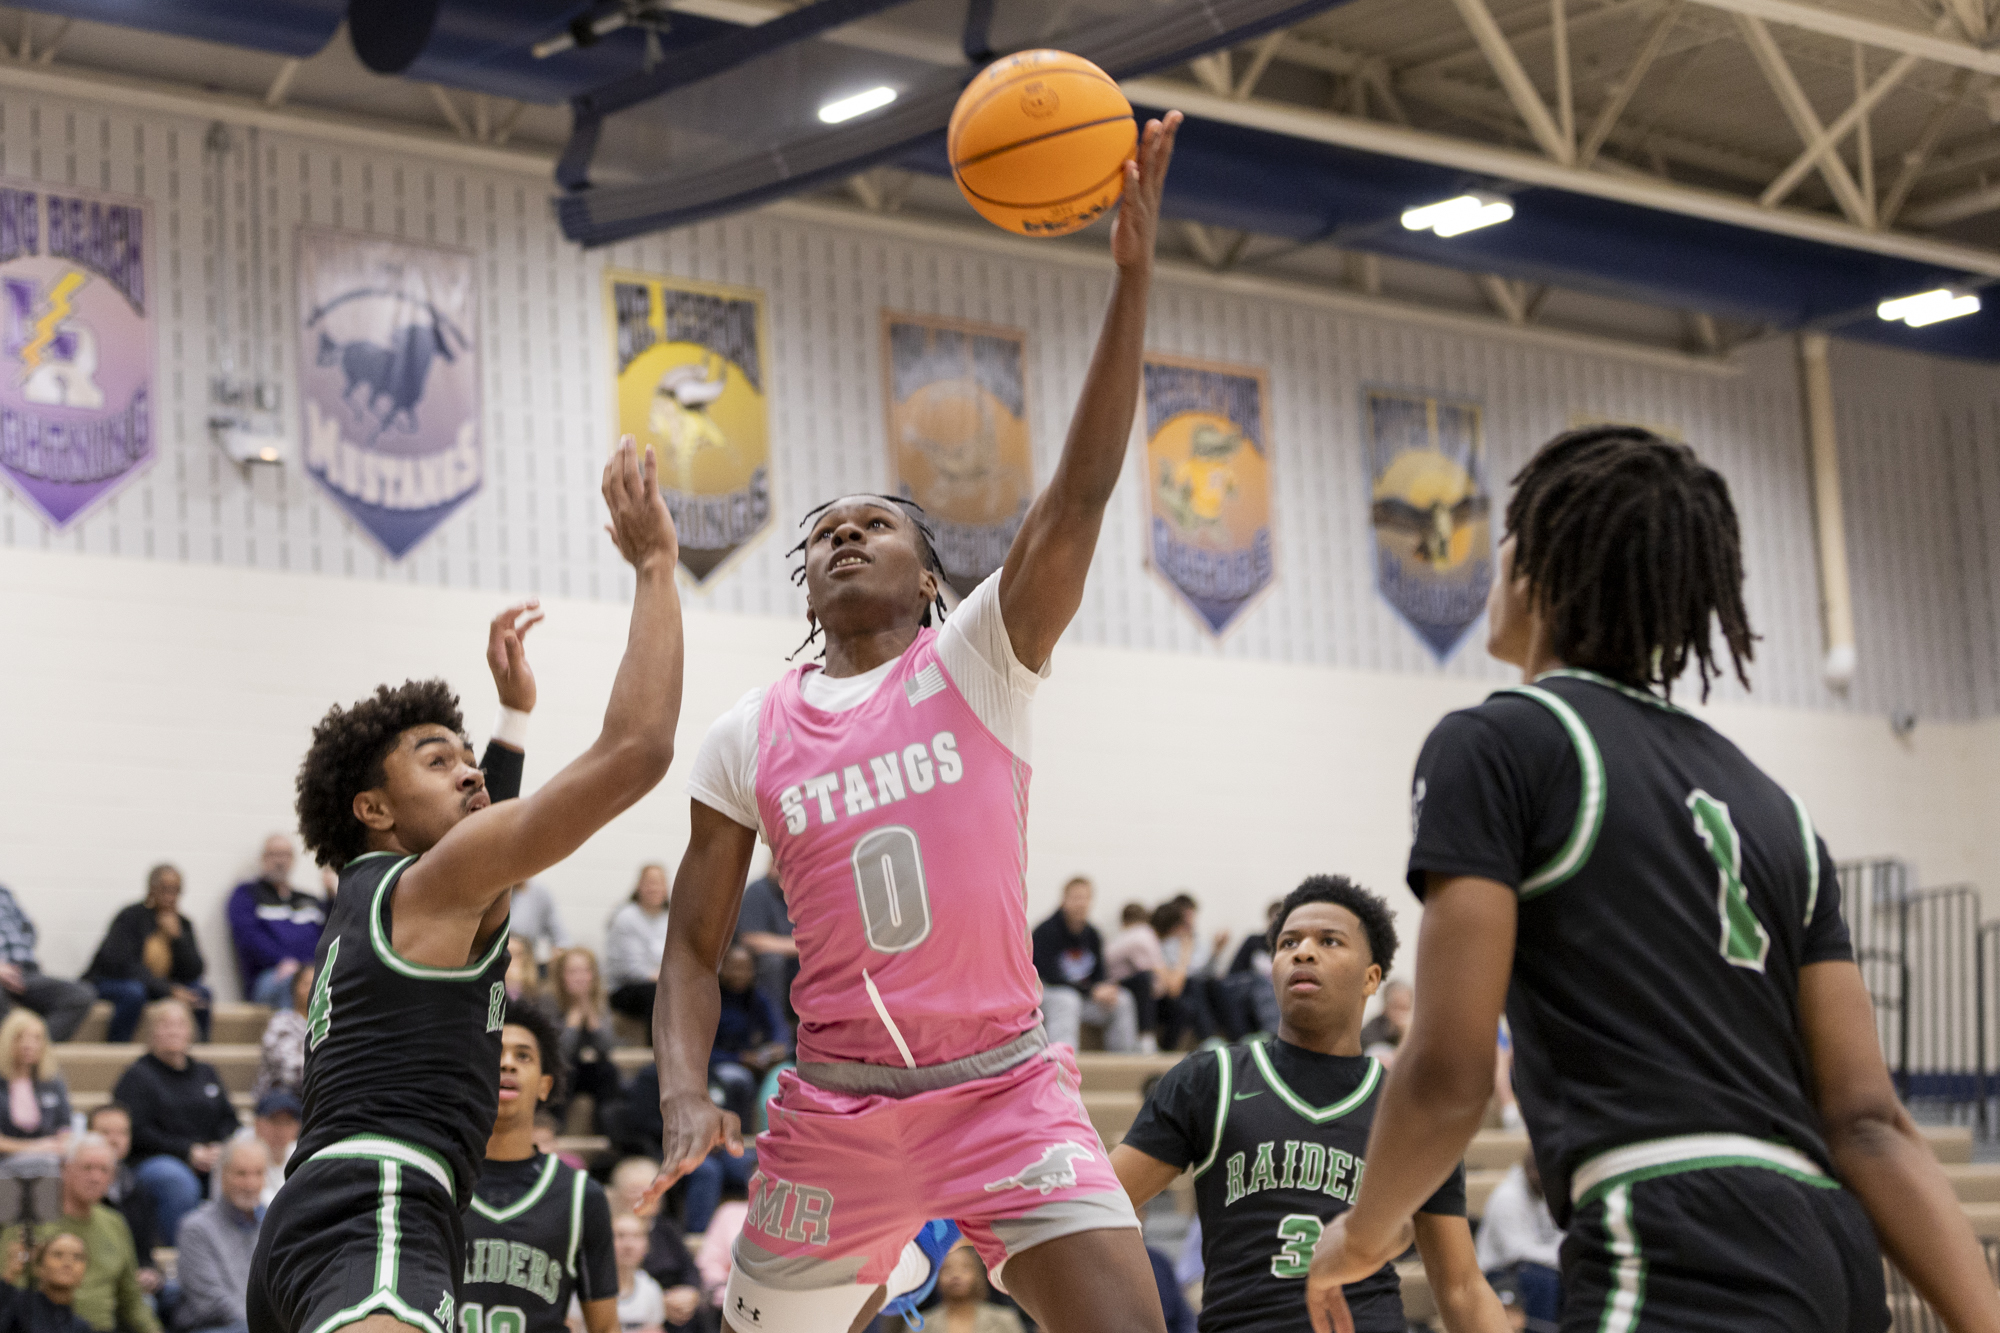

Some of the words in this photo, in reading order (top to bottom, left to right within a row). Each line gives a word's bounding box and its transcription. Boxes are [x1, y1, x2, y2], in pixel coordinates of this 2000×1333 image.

[779, 731, 964, 836] STANGS
[850, 823, 933, 954] 0
[1686, 787, 1771, 974] 1
[304, 934, 341, 1053] 4
[747, 1169, 834, 1247] MR
[1271, 1213, 1326, 1280] 3
[463, 1238, 562, 1305] IDERS
